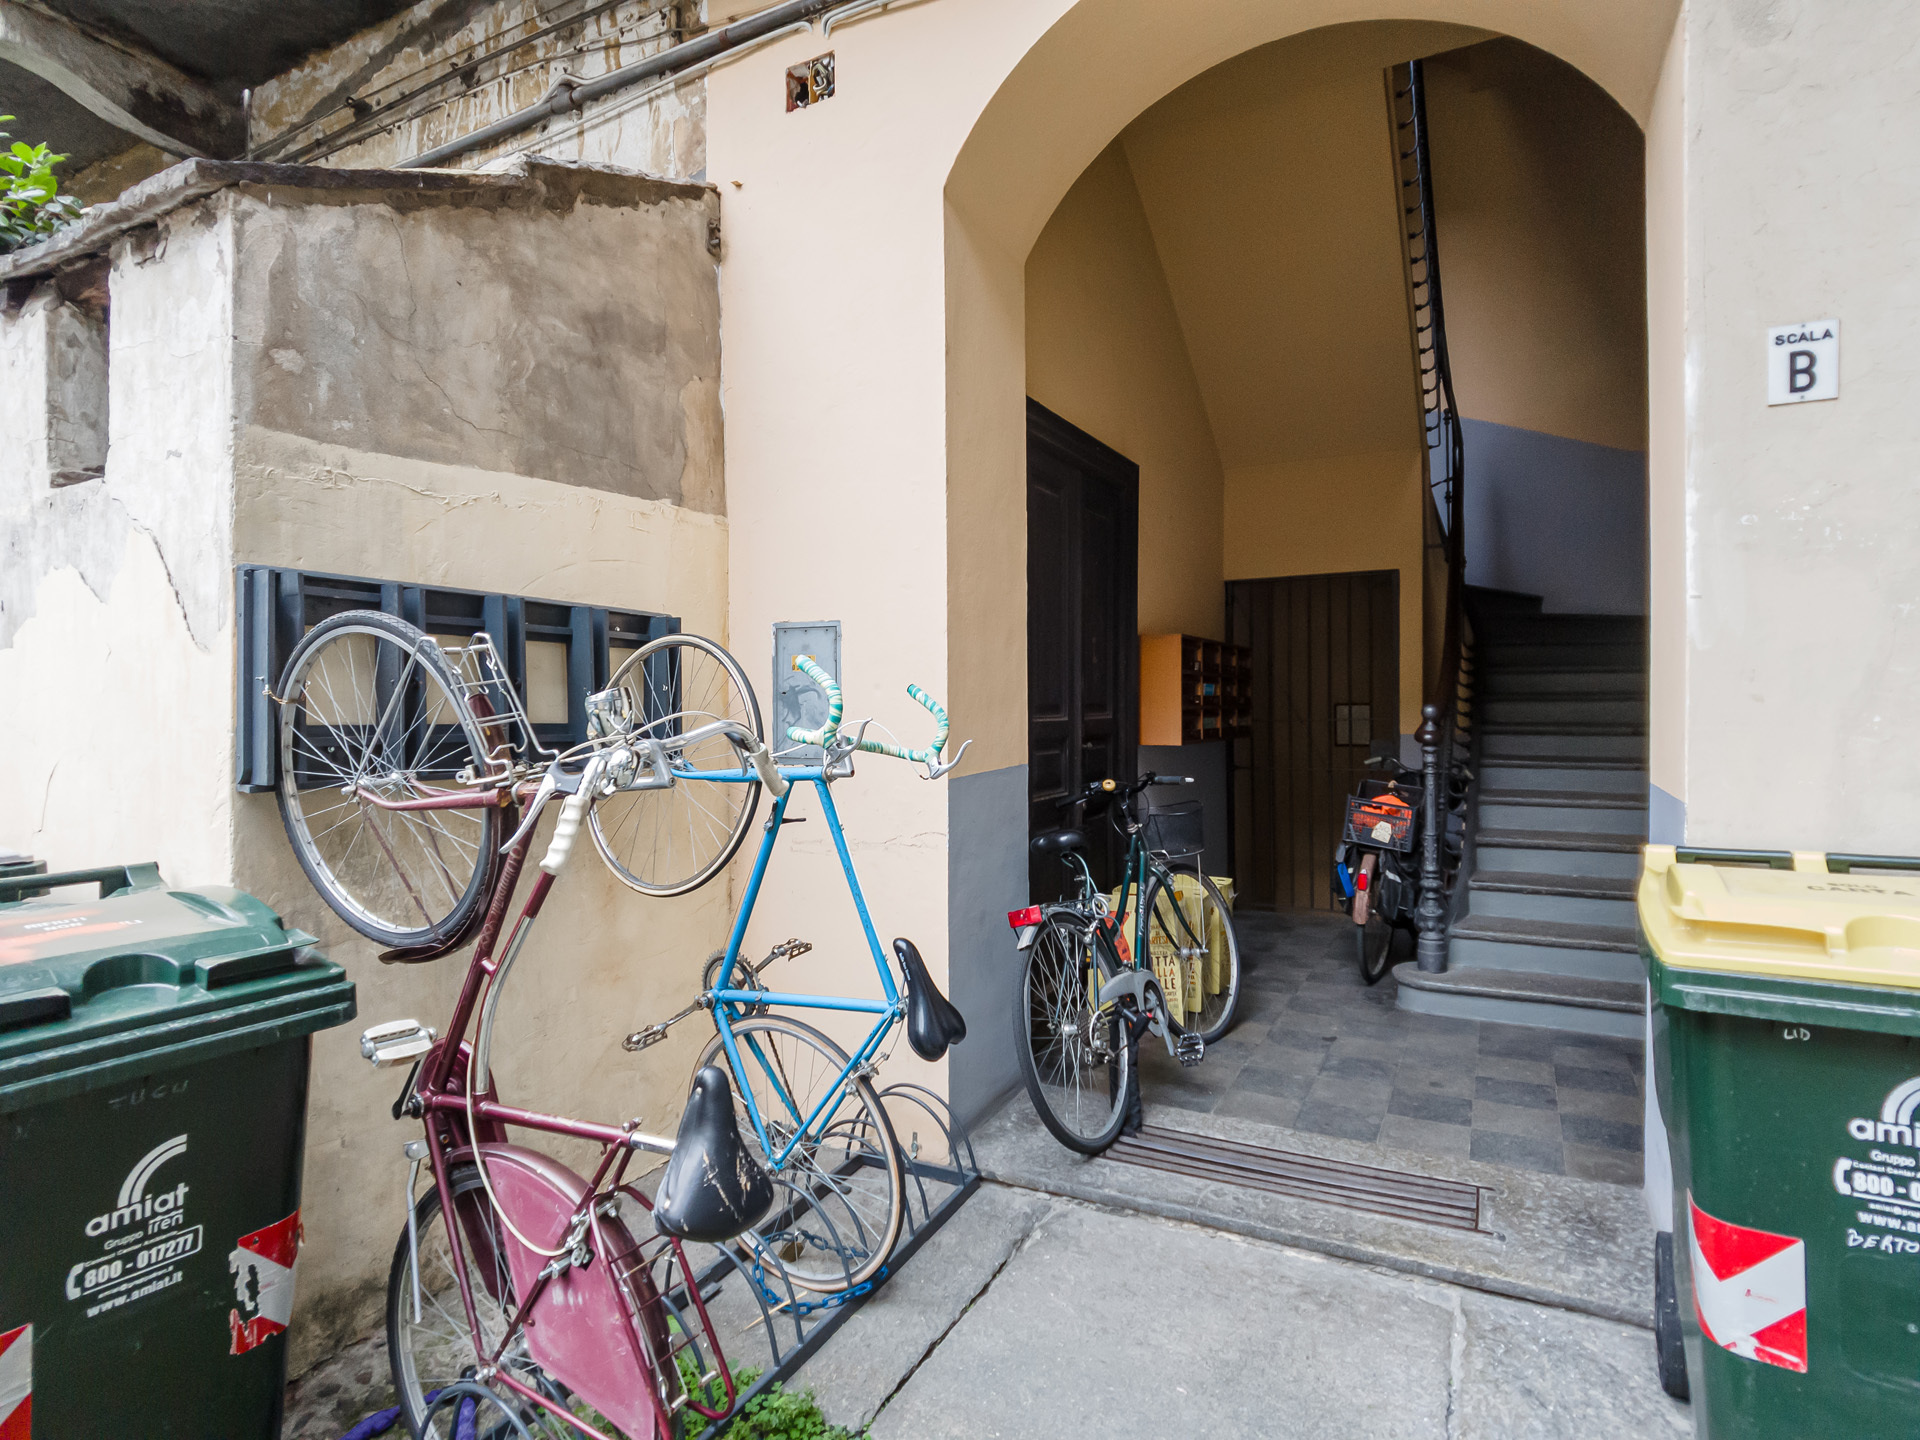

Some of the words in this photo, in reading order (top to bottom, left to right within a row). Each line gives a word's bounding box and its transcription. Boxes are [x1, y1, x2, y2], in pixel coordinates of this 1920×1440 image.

[1774, 328, 1834, 346] SCALA
[1789, 350, 1817, 394] B
[1870, 1149, 1916, 1168] Gruppo
[1852, 1170, 1894, 1197] 800
[85, 1182, 189, 1237] amiat
[104, 1231, 144, 1251] Gruppo
[83, 1260, 123, 1289] 800
[136, 1233, 194, 1269] 017277
[86, 1271, 184, 1319] www.amiat.it
